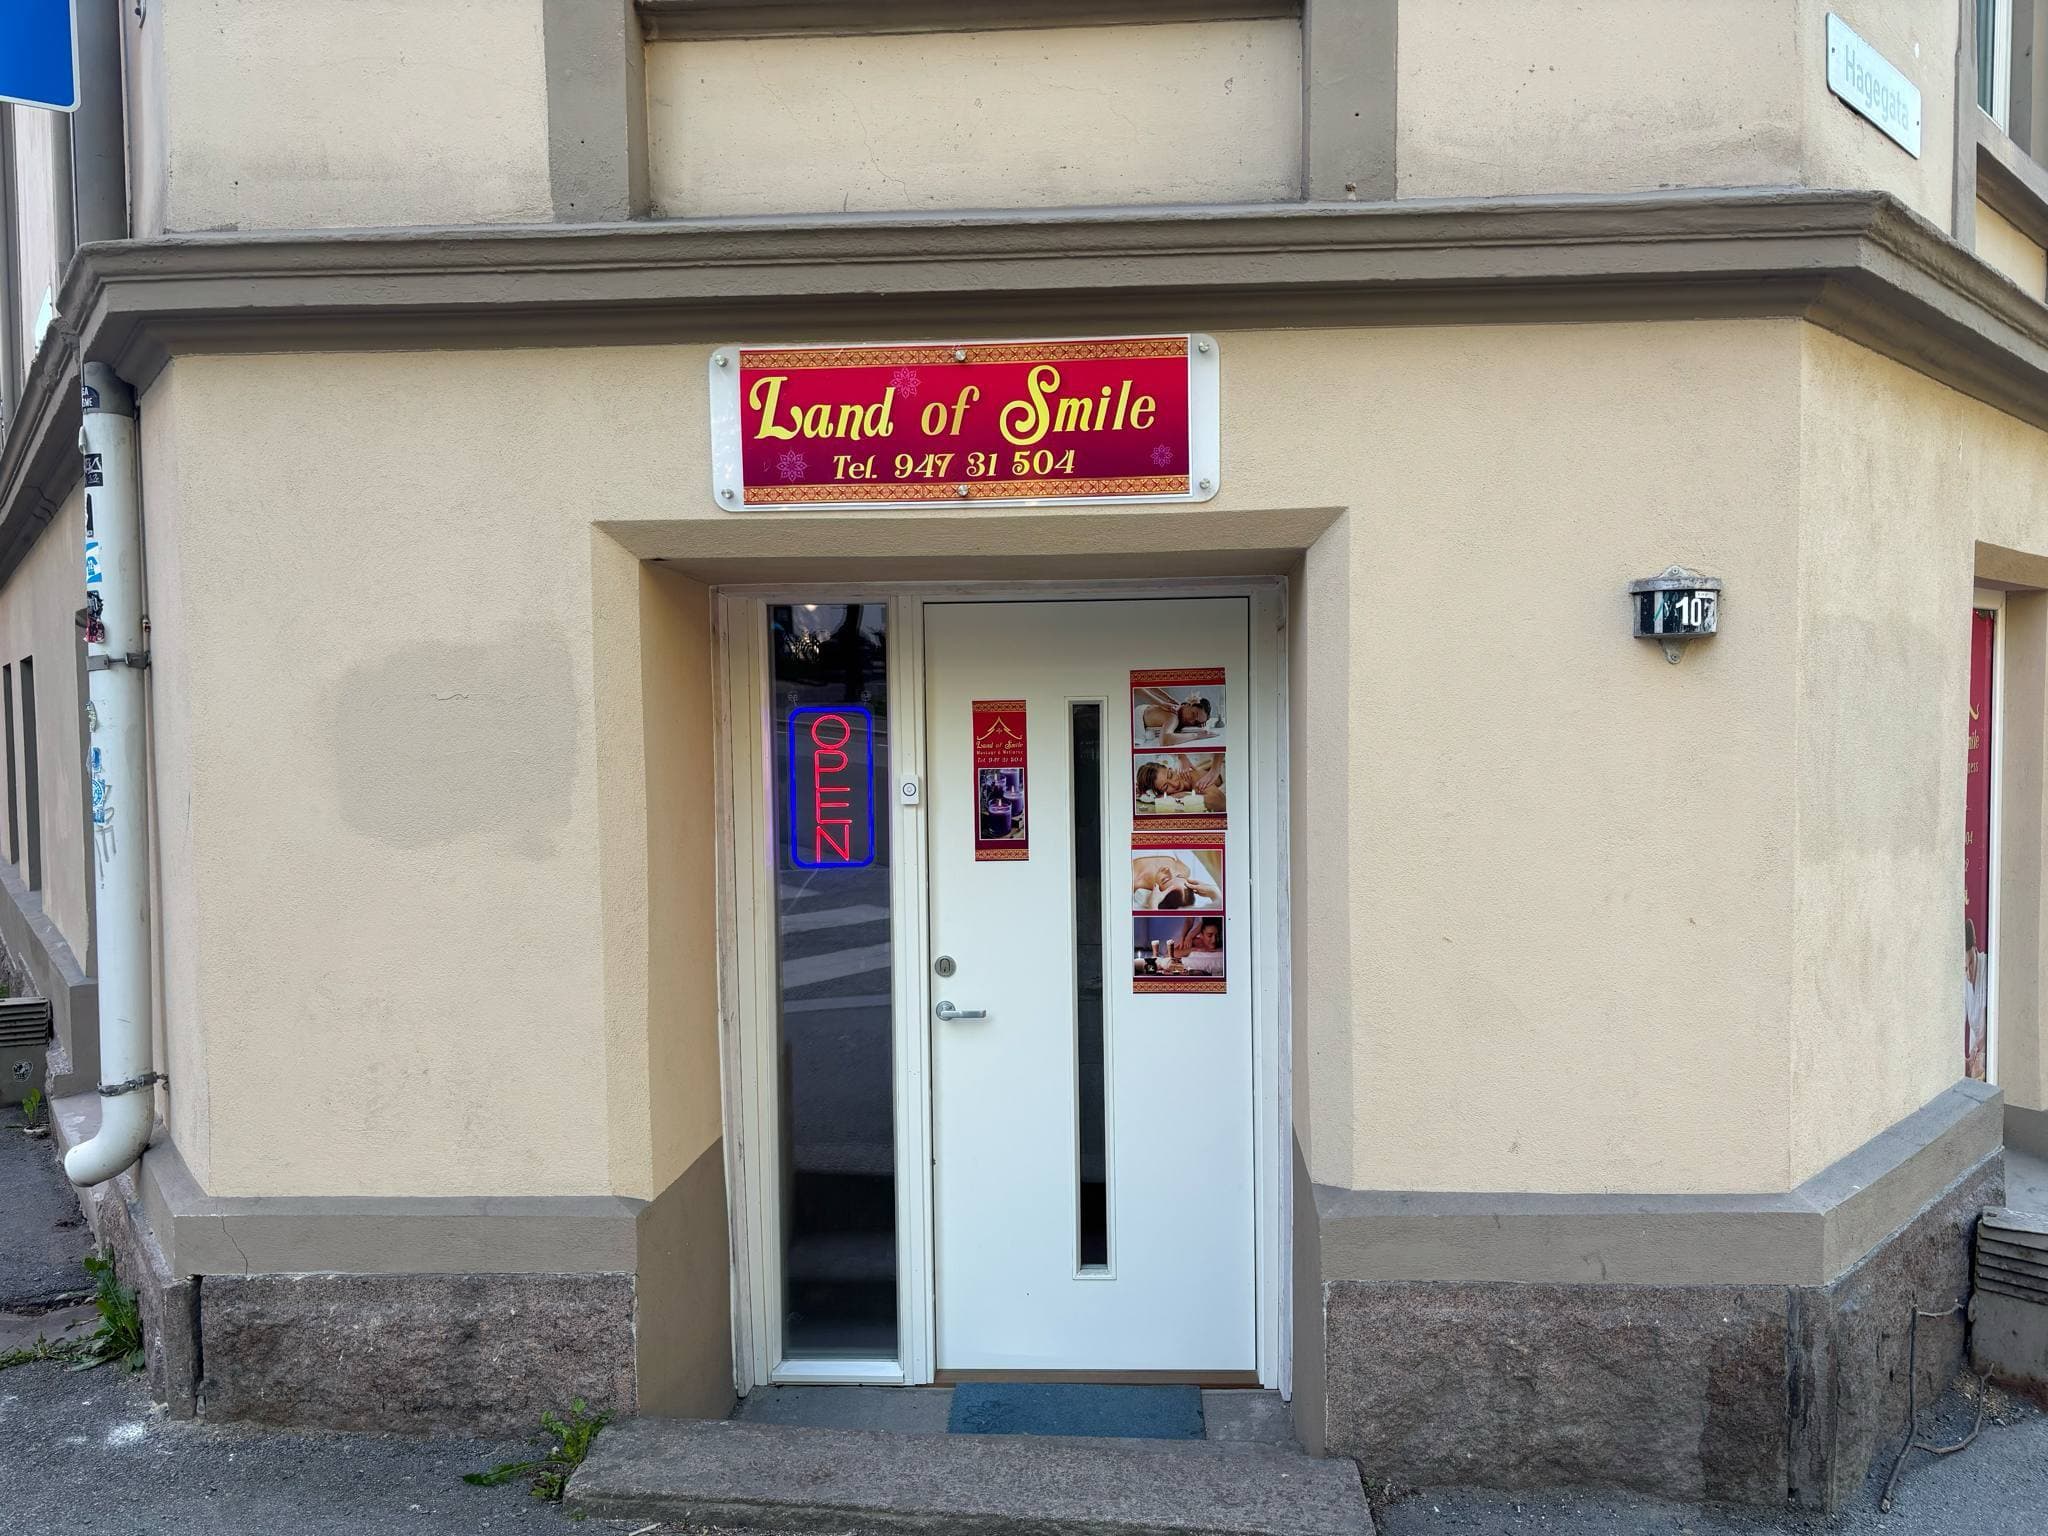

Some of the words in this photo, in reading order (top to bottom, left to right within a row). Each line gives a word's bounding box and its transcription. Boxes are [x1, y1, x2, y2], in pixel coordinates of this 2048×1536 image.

[1845, 44, 1909, 130] Hagegata
[749, 376, 895, 441] Land
[921, 385, 980, 437] of
[1000, 364, 1157, 446] Smile
[833, 454, 878, 480] Tel.
[894, 452, 954, 479] 947
[967, 451, 997, 477] 31
[1012, 450, 1076, 475] 504
[811, 714, 853, 864] OPEN
